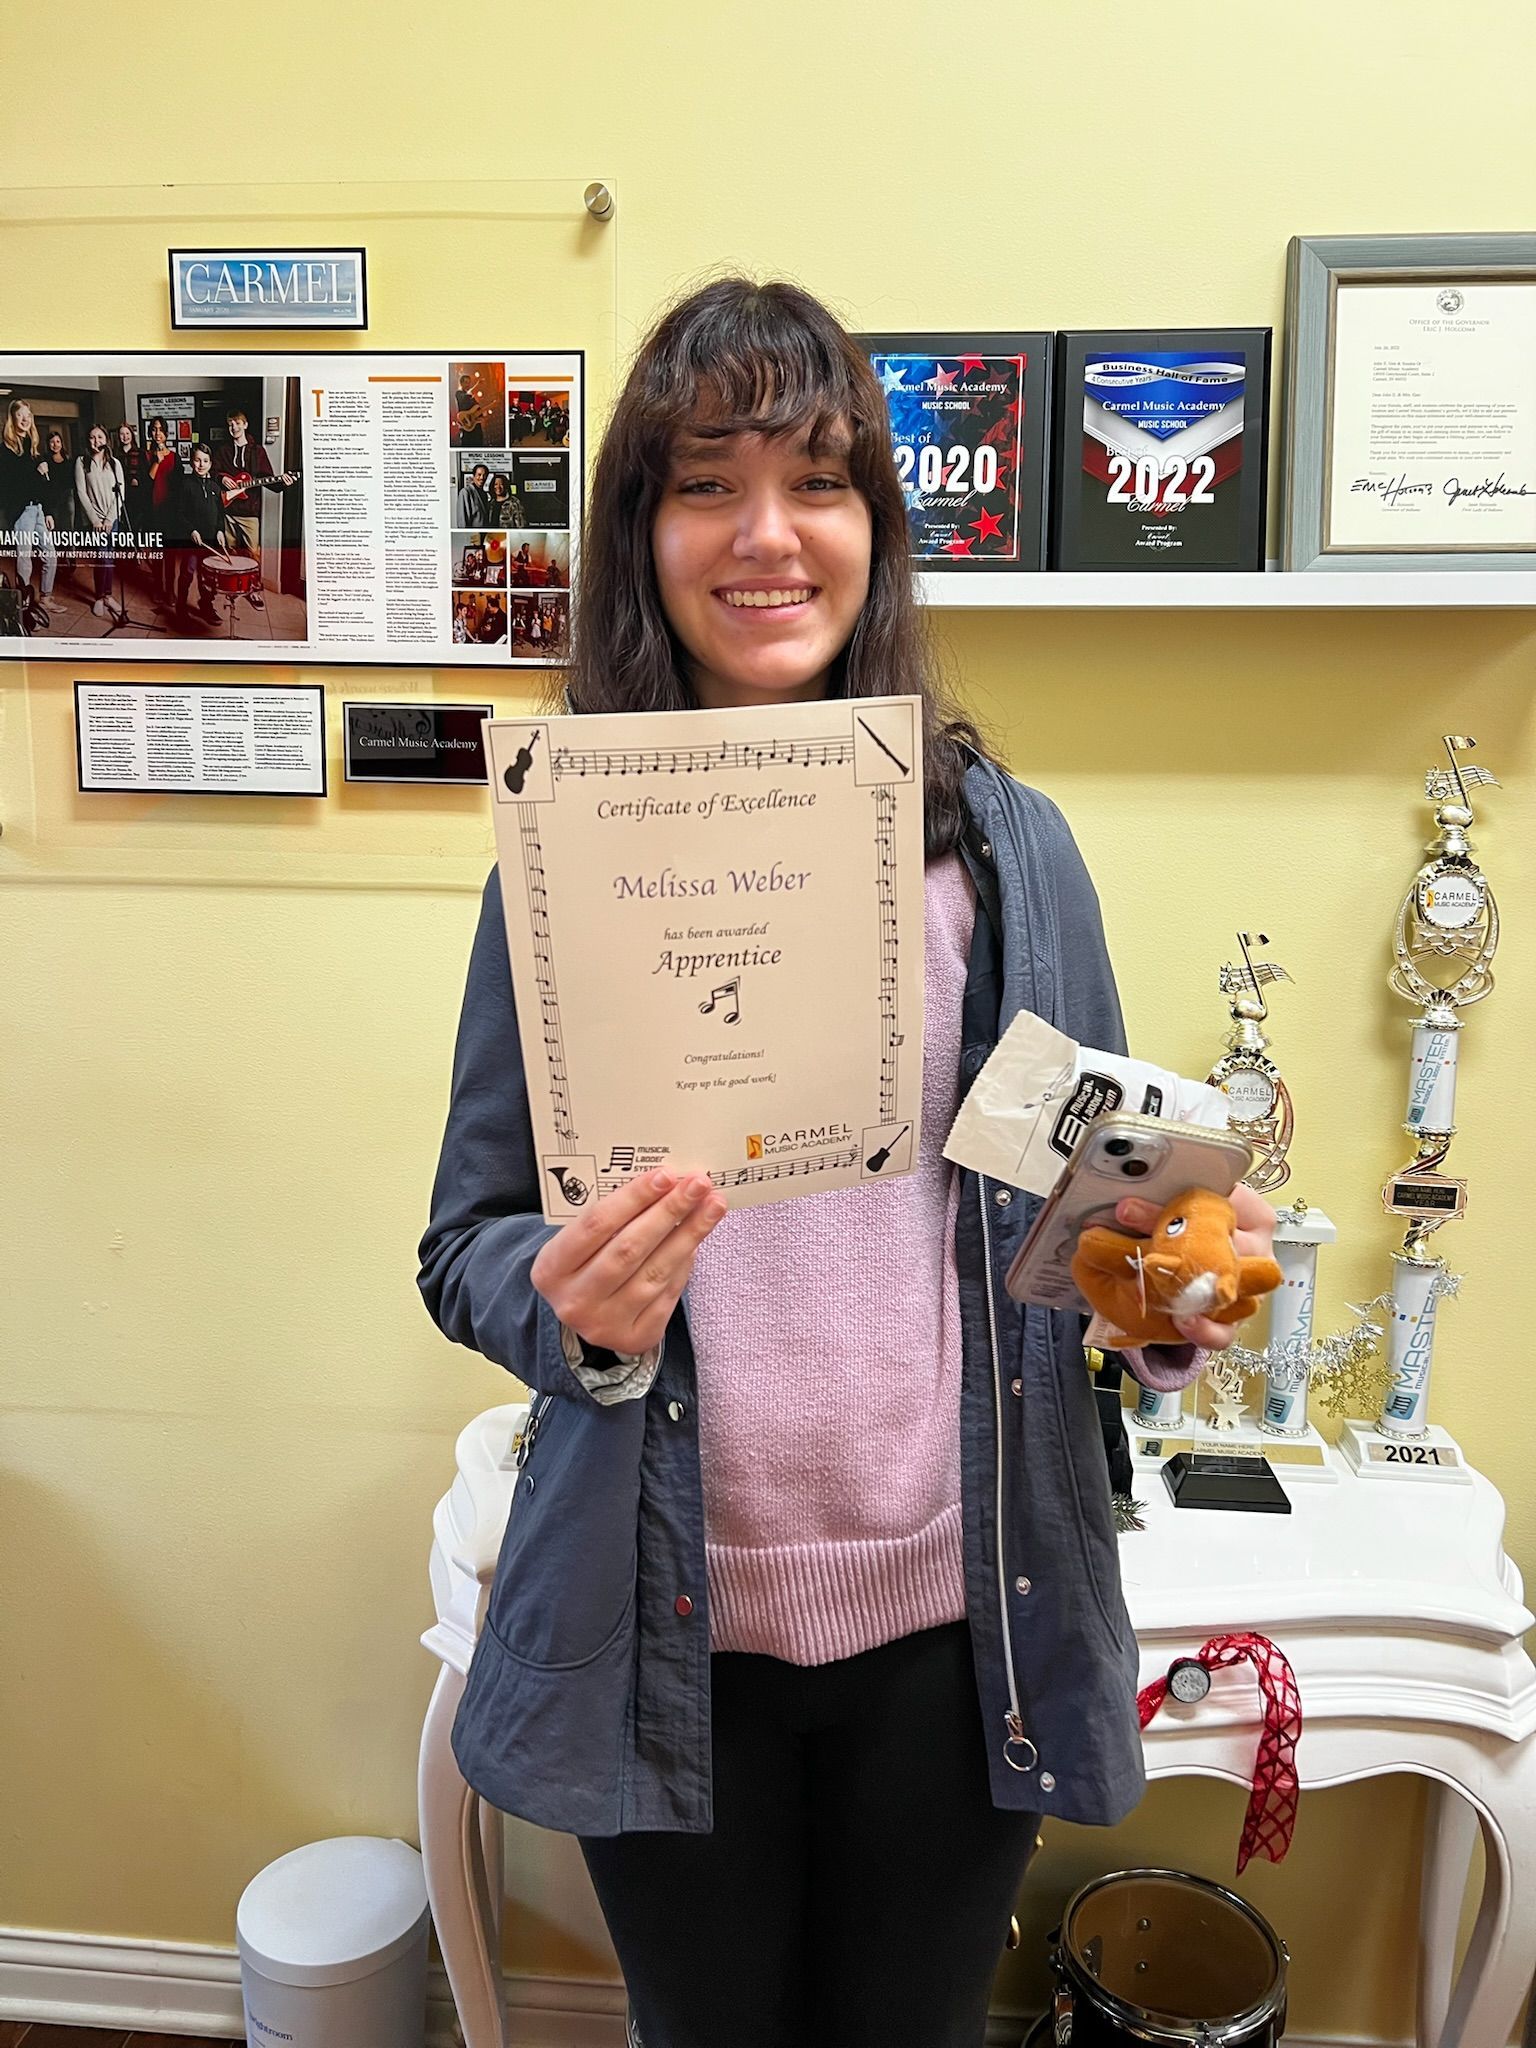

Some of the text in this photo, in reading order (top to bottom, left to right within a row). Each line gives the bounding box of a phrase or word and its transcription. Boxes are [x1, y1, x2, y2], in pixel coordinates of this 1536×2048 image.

[185, 262, 352, 304] CARMEL
[1096, 376, 1134, 385] Consecutive
[1135, 376, 1152, 384] Years
[1102, 363, 1228, 384] Business Hall of Fame
[888, 382, 1008, 394] Carmel Music Academy
[922, 401, 971, 410] MUSIC SCHOOL
[1102, 401, 1226, 412] Carmel Music Academy
[1138, 420, 1188, 429] MUSIC SCHOOL
[891, 432, 932, 444] Best of
[893, 444, 998, 494] 2020
[1106, 455, 1216, 504] 2022
[912, 490, 978, 508] Carmel
[1127, 494, 1192, 512] Carmel
[44, 530, 111, 547] MUSICIANS
[112, 532, 134, 548] FOR
[138, 532, 164, 548] LIFE
[19, 550, 37, 558] MUSIC
[38, 551, 66, 559] ACADEMY
[66, 551, 97, 559] INSTRUCTS
[98, 552, 126, 560] STUDENTS
[128, 552, 136, 560] OF
[136, 552, 148, 560] ALL
[148, 552, 164, 560] AGES
[359, 736, 478, 752] Carmel Music Academy
[597, 788, 817, 822] Certificate of Excellence
[613, 861, 812, 900] Melissa Weber
[1434, 892, 1478, 901] CARMEL
[664, 922, 770, 940] has been awarded
[652, 944, 782, 978] Apprentice
[684, 1048, 766, 1066] Congratulations!
[1412, 1033, 1446, 1104] MASTER
[675, 1072, 778, 1092] Keep up the good work!
[1228, 1086, 1272, 1096] CARMEL
[764, 1123, 854, 1146] CARMEL
[764, 1134, 853, 1156] MUSIC ACADEMY
[1394, 1277, 1439, 1389] MASTE
[1384, 1444, 1440, 1465] 2021
